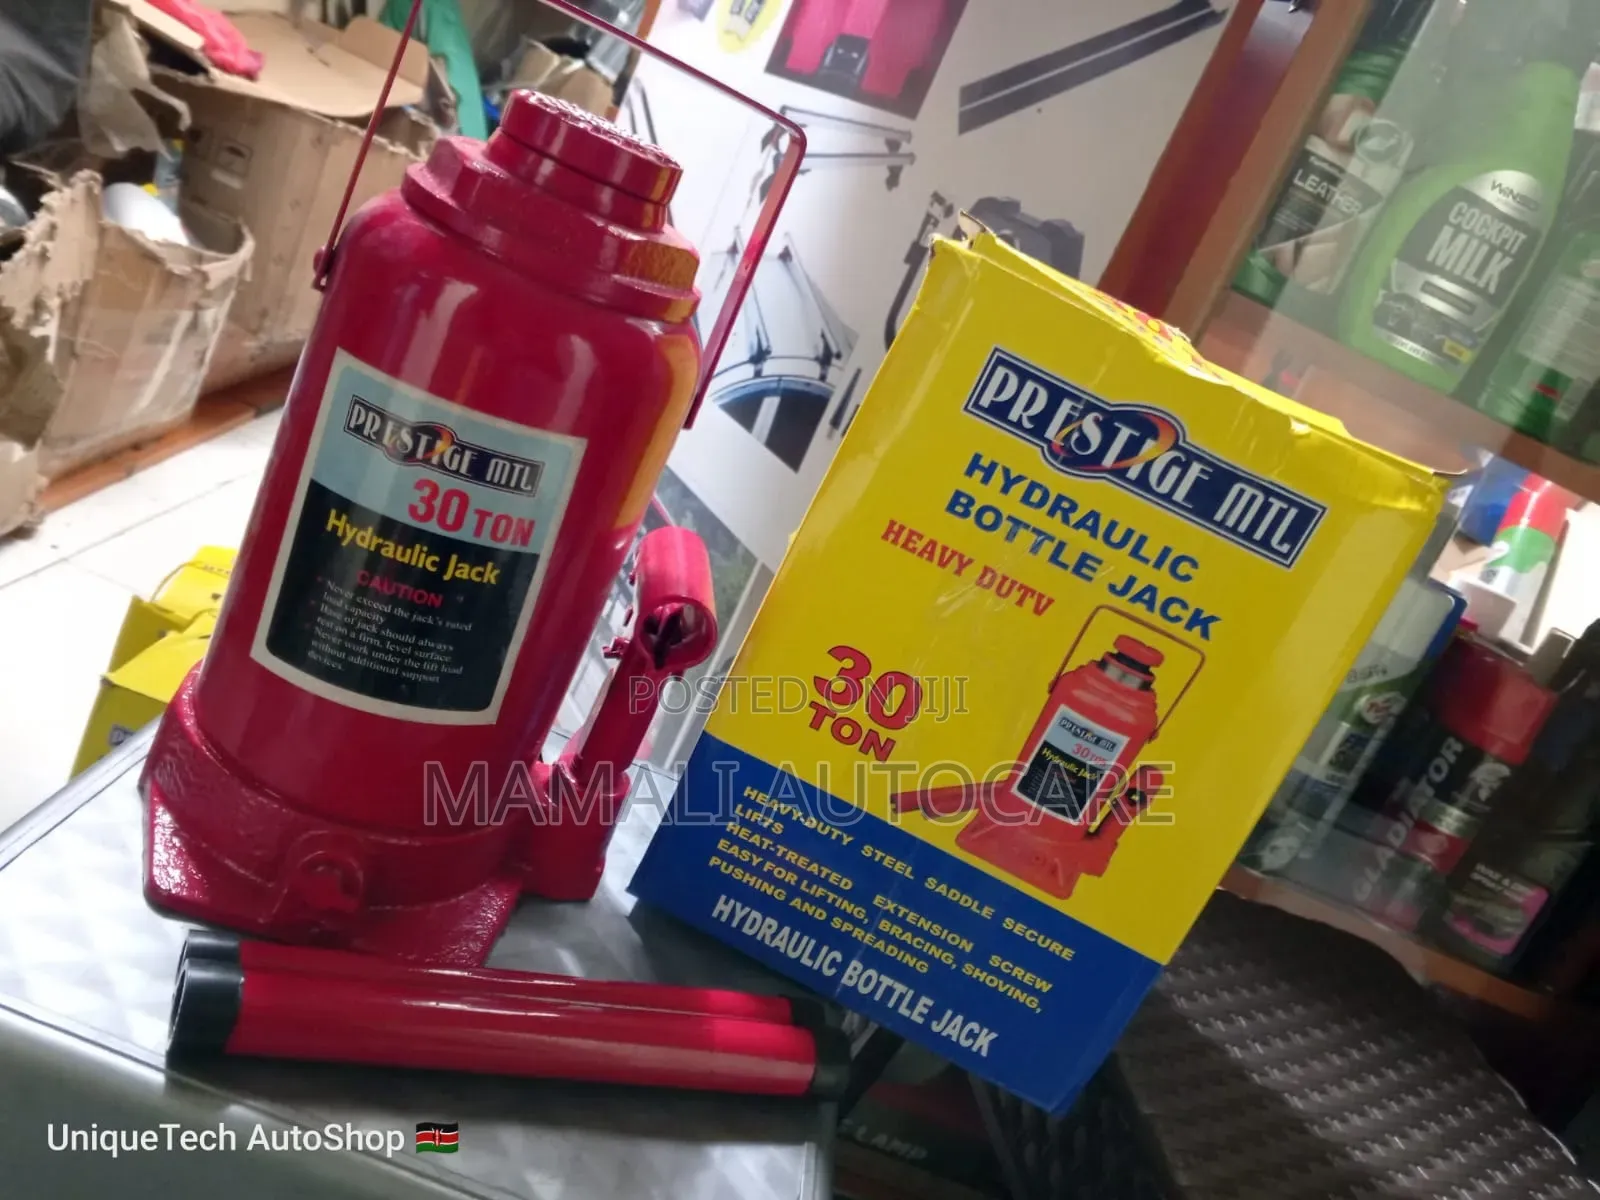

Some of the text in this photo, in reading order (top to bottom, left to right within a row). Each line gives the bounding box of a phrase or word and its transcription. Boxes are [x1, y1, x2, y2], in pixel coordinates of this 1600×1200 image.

[1293, 168, 1362, 214] LEATHER
[1425, 226, 1515, 295] MILK
[1448, 201, 1527, 255] COCKPIT
[349, 403, 532, 490] PRESTIGE MTL
[978, 364, 1299, 554] PRESTIGE MTL
[326, 508, 501, 585] Hydraulic Jack
[408, 478, 536, 547] 30 TON
[963, 452, 1200, 583] HYDRAULIC
[881, 519, 975, 577] HEAVY
[945, 489, 1222, 642] BOTTLE JACK
[326, 580, 354, 600] Never
[356, 595, 391, 613] exceed
[393, 607, 410, 618] the
[356, 570, 444, 608] CAUTION
[311, 639, 347, 660] without
[348, 654, 400, 676] additional
[313, 626, 343, 646] Never
[371, 649, 401, 664] under
[404, 658, 421, 669] the
[355, 618, 378, 634] jack
[381, 626, 416, 644] should
[418, 638, 454, 652] always
[386, 641, 412, 656] level
[414, 648, 452, 663] surface
[813, 644, 924, 731] 30
[808, 701, 897, 763] TON
[1071, 742, 1089, 758] 30
[734, 803, 784, 836] LIFTS
[725, 821, 1053, 993] HEAT-TREATED EXTENSION SCREW
[742, 785, 1076, 962] HEAVY-DUTY STEEL SADDLE SECURE
[708, 855, 930, 974] PUSHING AND SPREADING
[716, 838, 1043, 1013] EASY FOR LIFTING, BRACING, SHOVING,
[711, 894, 1000, 1058] HYDRAULIC BOTTLE JACK
